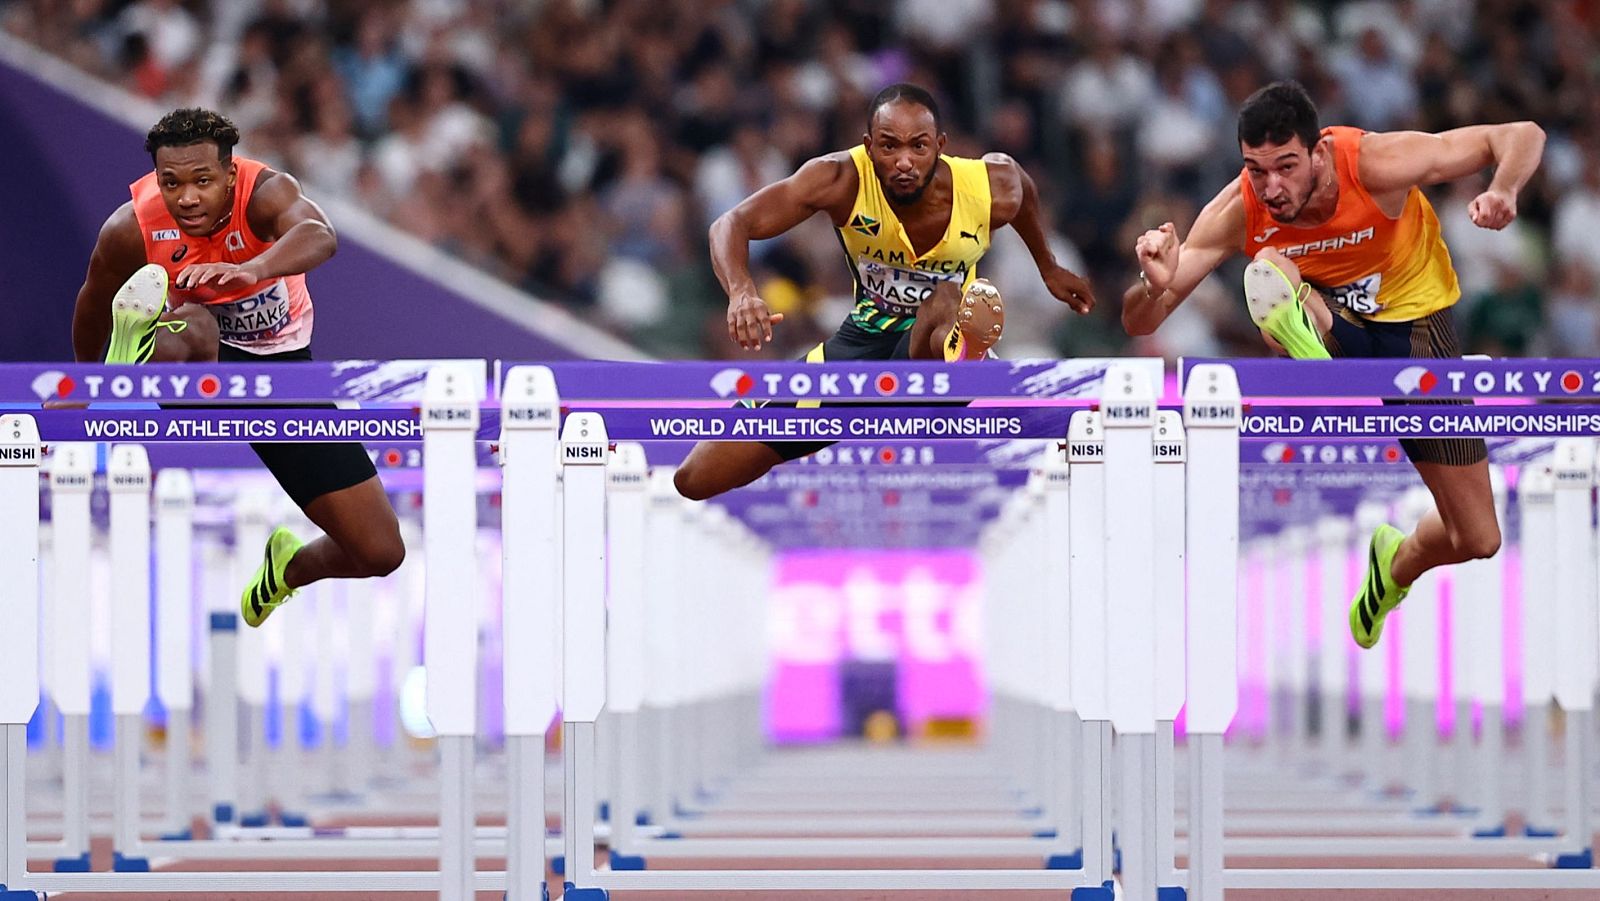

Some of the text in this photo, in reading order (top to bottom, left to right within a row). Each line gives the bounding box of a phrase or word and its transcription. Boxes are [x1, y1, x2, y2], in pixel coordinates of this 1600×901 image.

[154, 230, 178, 240] ACN
[861, 246, 968, 273] JAMAICA
[428, 409, 472, 420] NISHI
[508, 408, 552, 420] NISHI
[1106, 406, 1150, 419] NISHI
[1191, 406, 1235, 419] NISHI
[84, 419, 159, 438] WORLD
[165, 419, 277, 438] ATHLETICS
[650, 416, 1022, 437] WORLD ATHLETICS CHAMPIONSHIPS
[1239, 414, 1600, 434] WORLD ATHLETICS CHAMPIONSHIPS
[0, 448, 35, 460] NISHI
[566, 447, 603, 458] NISHI
[1153, 445, 1182, 456] ISHI
